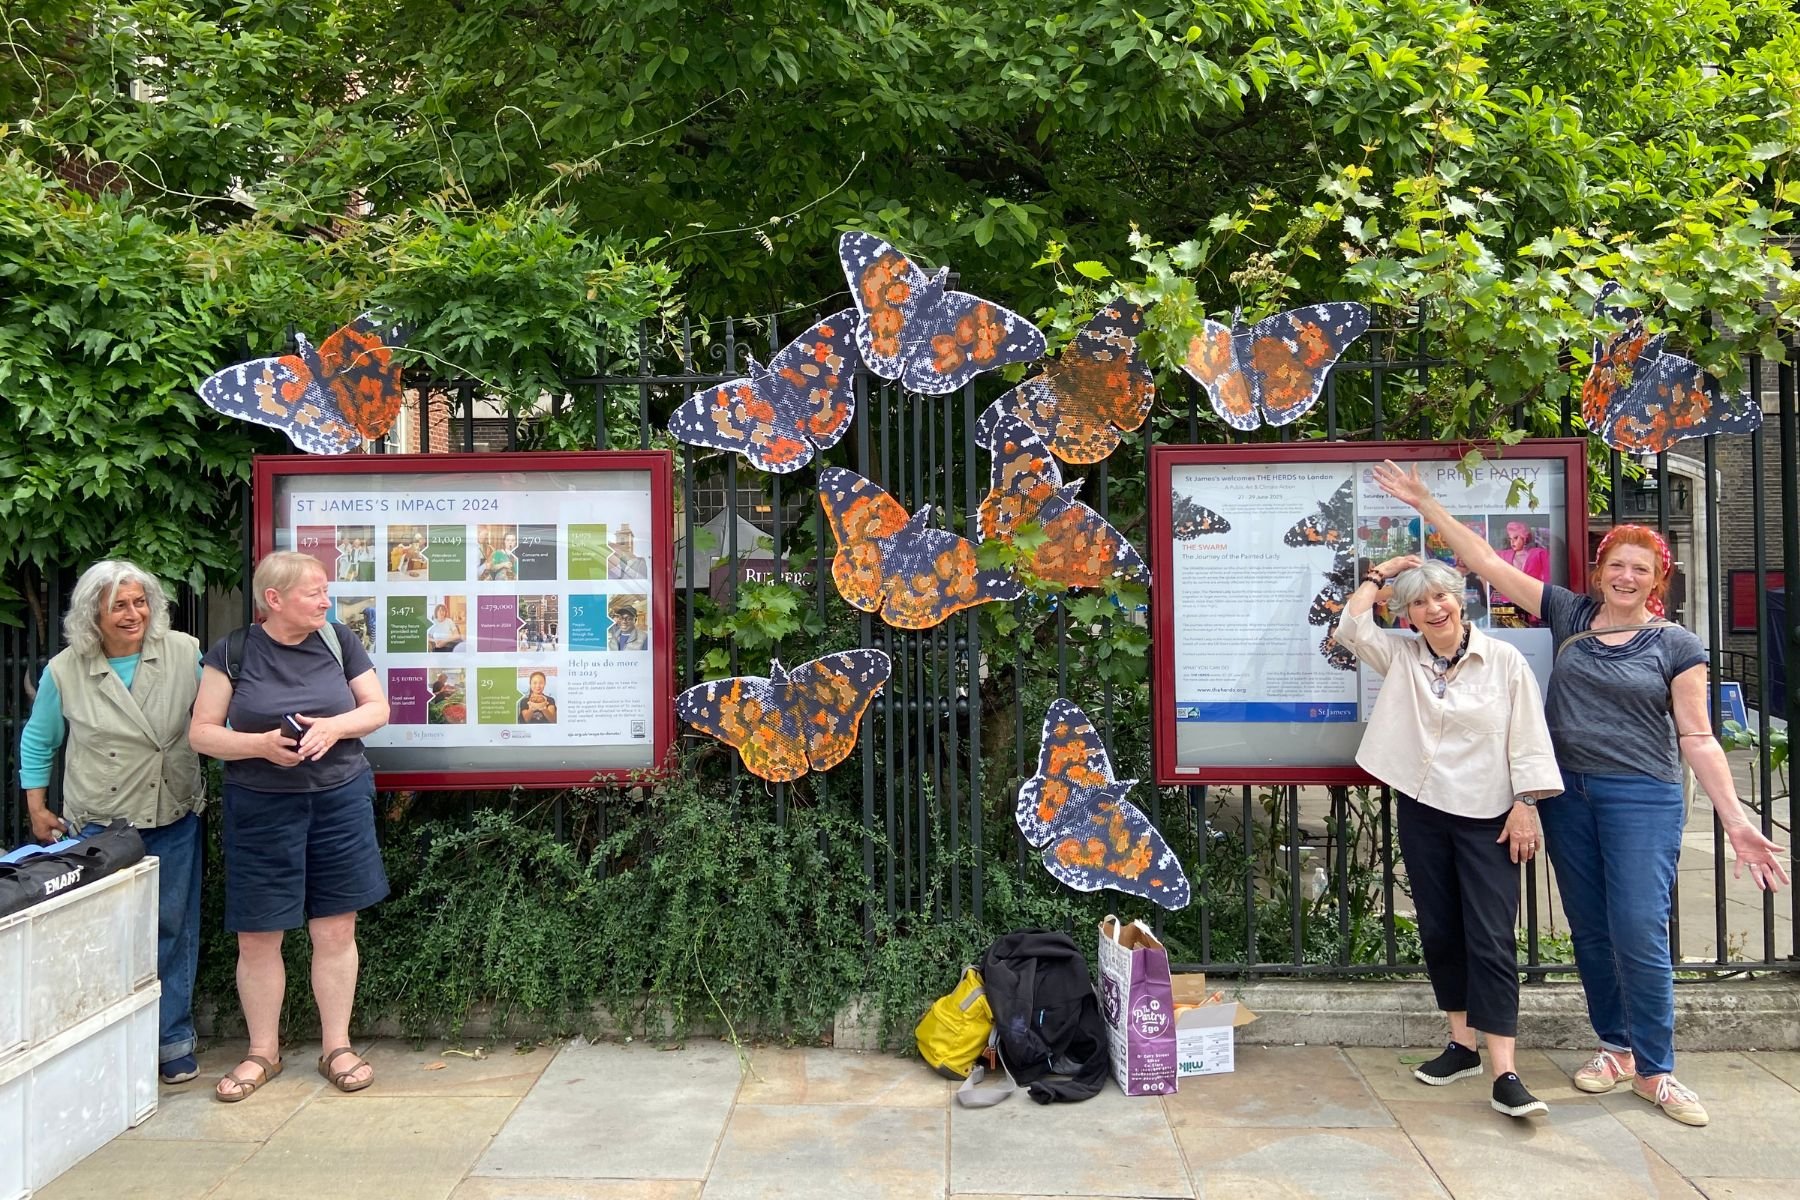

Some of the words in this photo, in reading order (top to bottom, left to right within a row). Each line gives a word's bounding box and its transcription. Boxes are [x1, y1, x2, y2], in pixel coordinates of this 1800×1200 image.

[1490, 467, 1540, 480] PARTY
[297, 500, 316, 512] ST
[321, 499, 389, 512] JAMES'S
[396, 499, 456, 511] IMPACT
[462, 499, 499, 511] 2024
[301, 537, 319, 547] 473
[431, 536, 462, 546] 21,049
[521, 536, 541, 547] 270
[1195, 553, 1220, 561] Journey
[572, 606, 584, 617] 35
[568, 659, 589, 669] Help
[603, 659, 614, 667] do
[480, 679, 494, 689] 29
[1326, 708, 1351, 718] James's
[1133, 1009, 1167, 1026] Pantry
[1141, 1026, 1159, 1034] 2go
